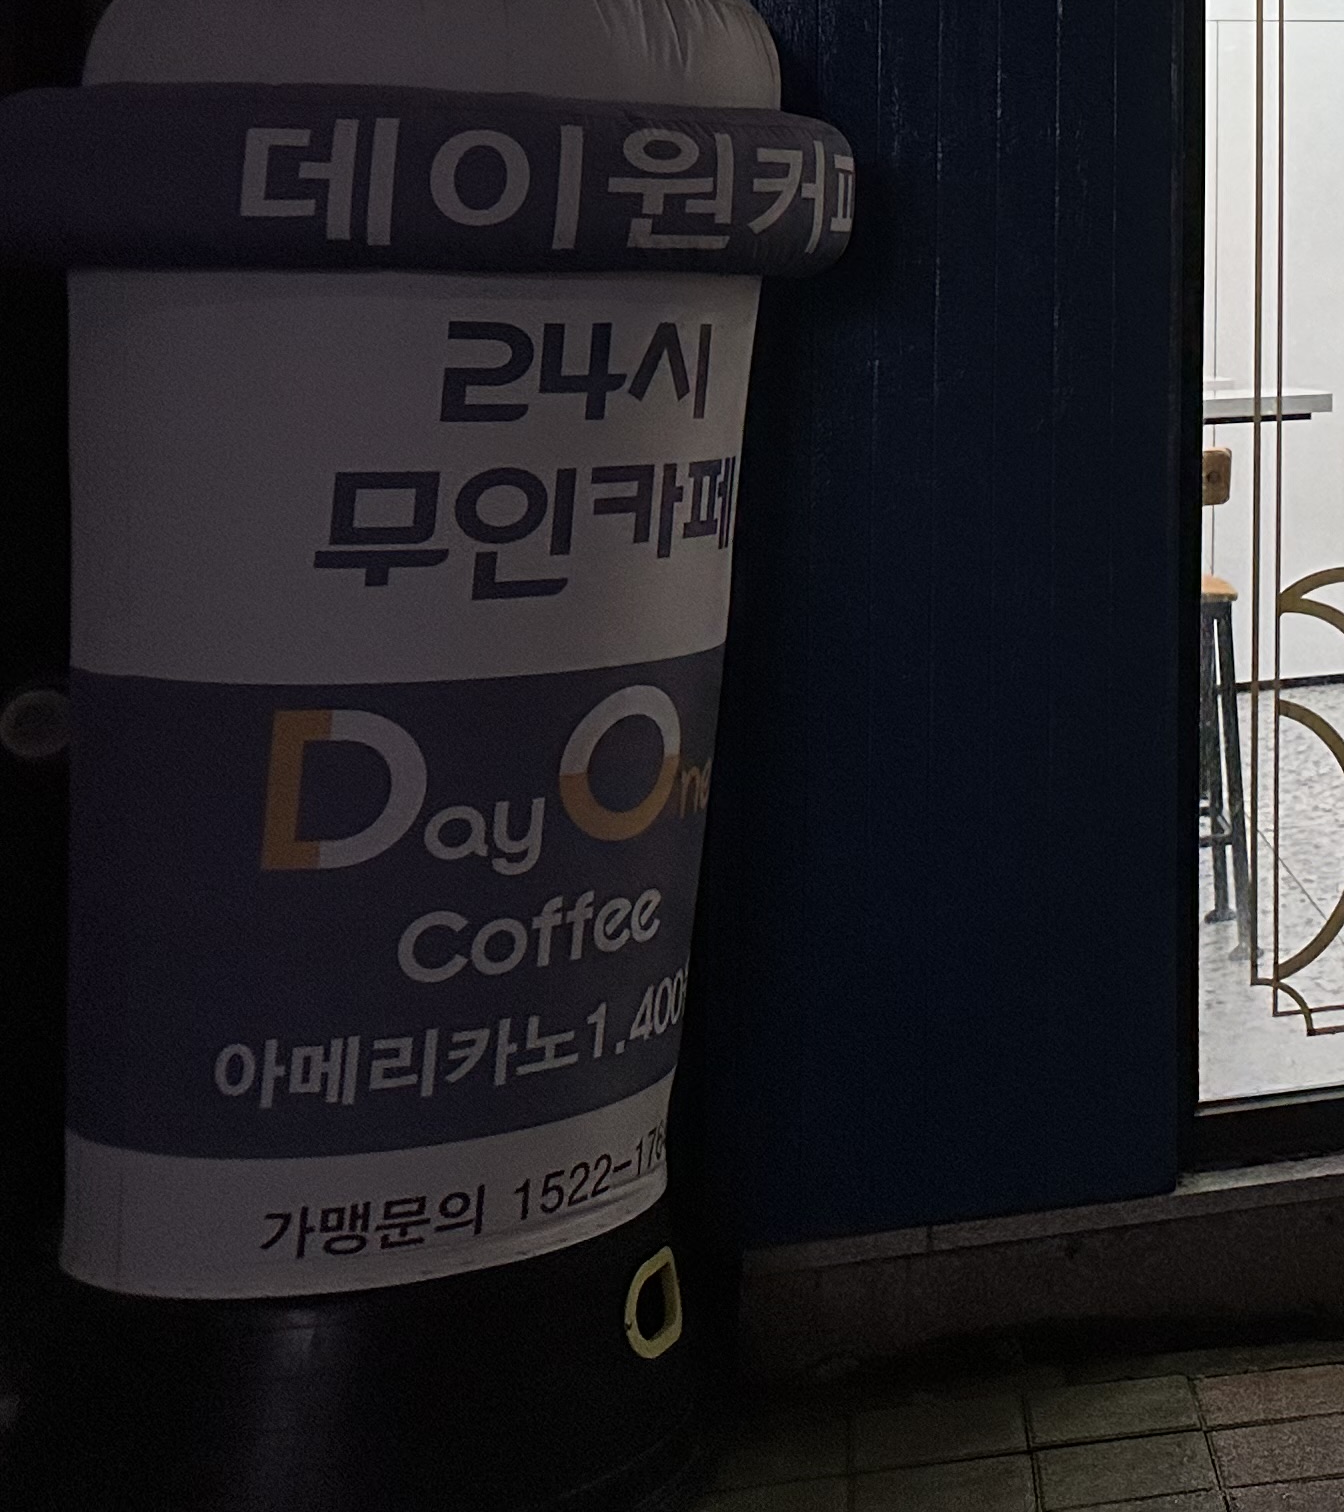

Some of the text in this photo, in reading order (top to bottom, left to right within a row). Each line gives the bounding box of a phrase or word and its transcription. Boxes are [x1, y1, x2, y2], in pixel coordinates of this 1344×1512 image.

[439, 320, 713, 424] 24시
[313, 455, 738, 602] 무인카페
[260, 707, 547, 876] Day
[397, 887, 663, 985] Coffee
[258, 1184, 486, 1261] 가맹문의
